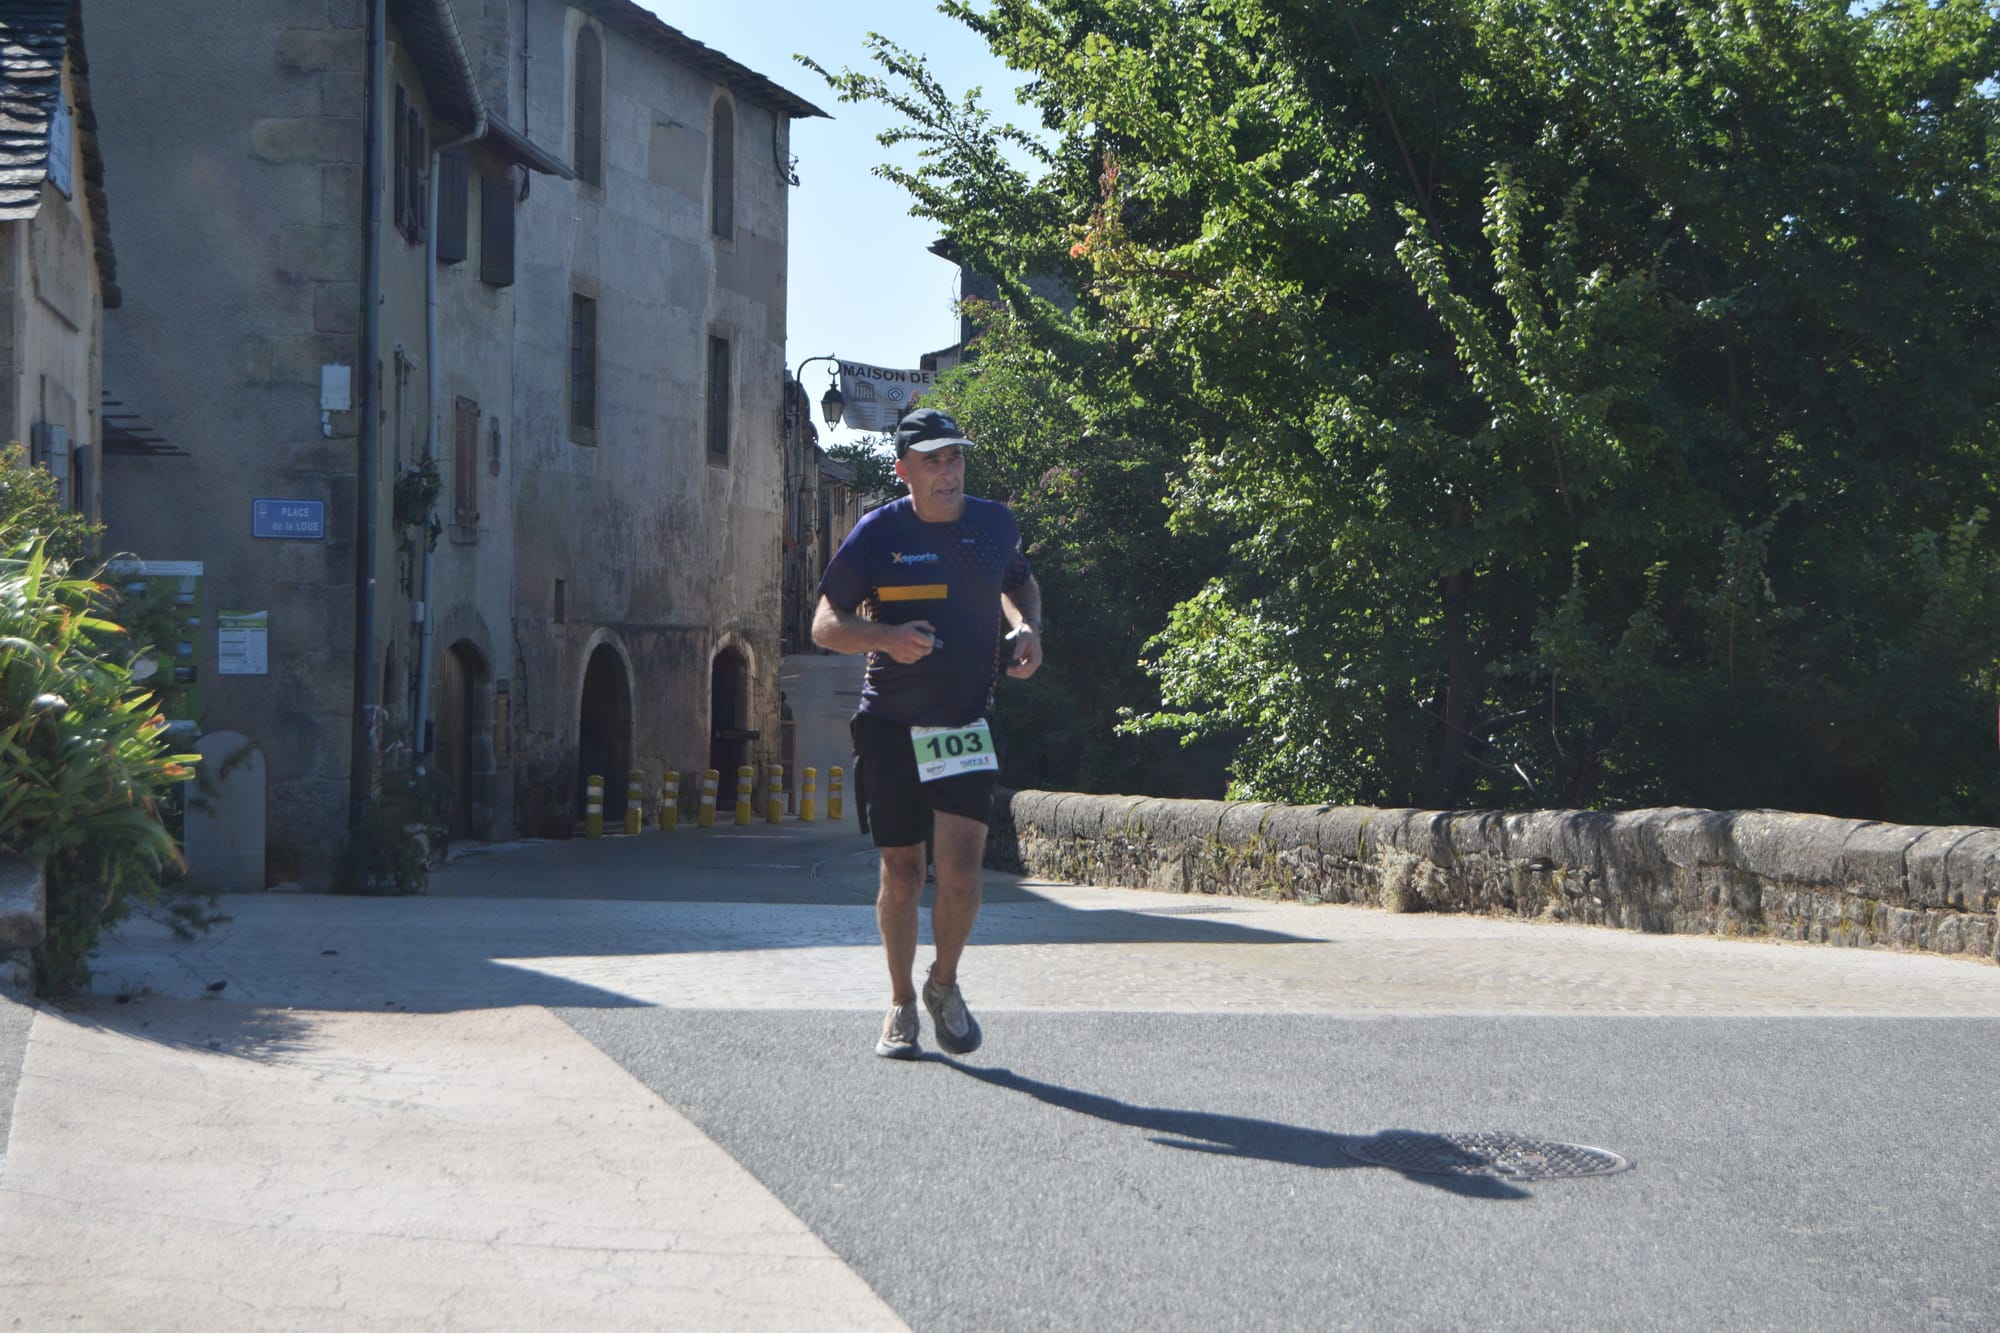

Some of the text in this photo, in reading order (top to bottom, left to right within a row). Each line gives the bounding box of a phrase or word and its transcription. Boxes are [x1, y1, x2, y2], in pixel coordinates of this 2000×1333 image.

[843, 364, 905, 382] MAISON
[910, 372, 930, 384] DE
[281, 506, 310, 517] PLACE
[296, 520, 319, 531] LOUE
[891, 552, 938, 565] Xsports
[927, 732, 983, 758] 103
